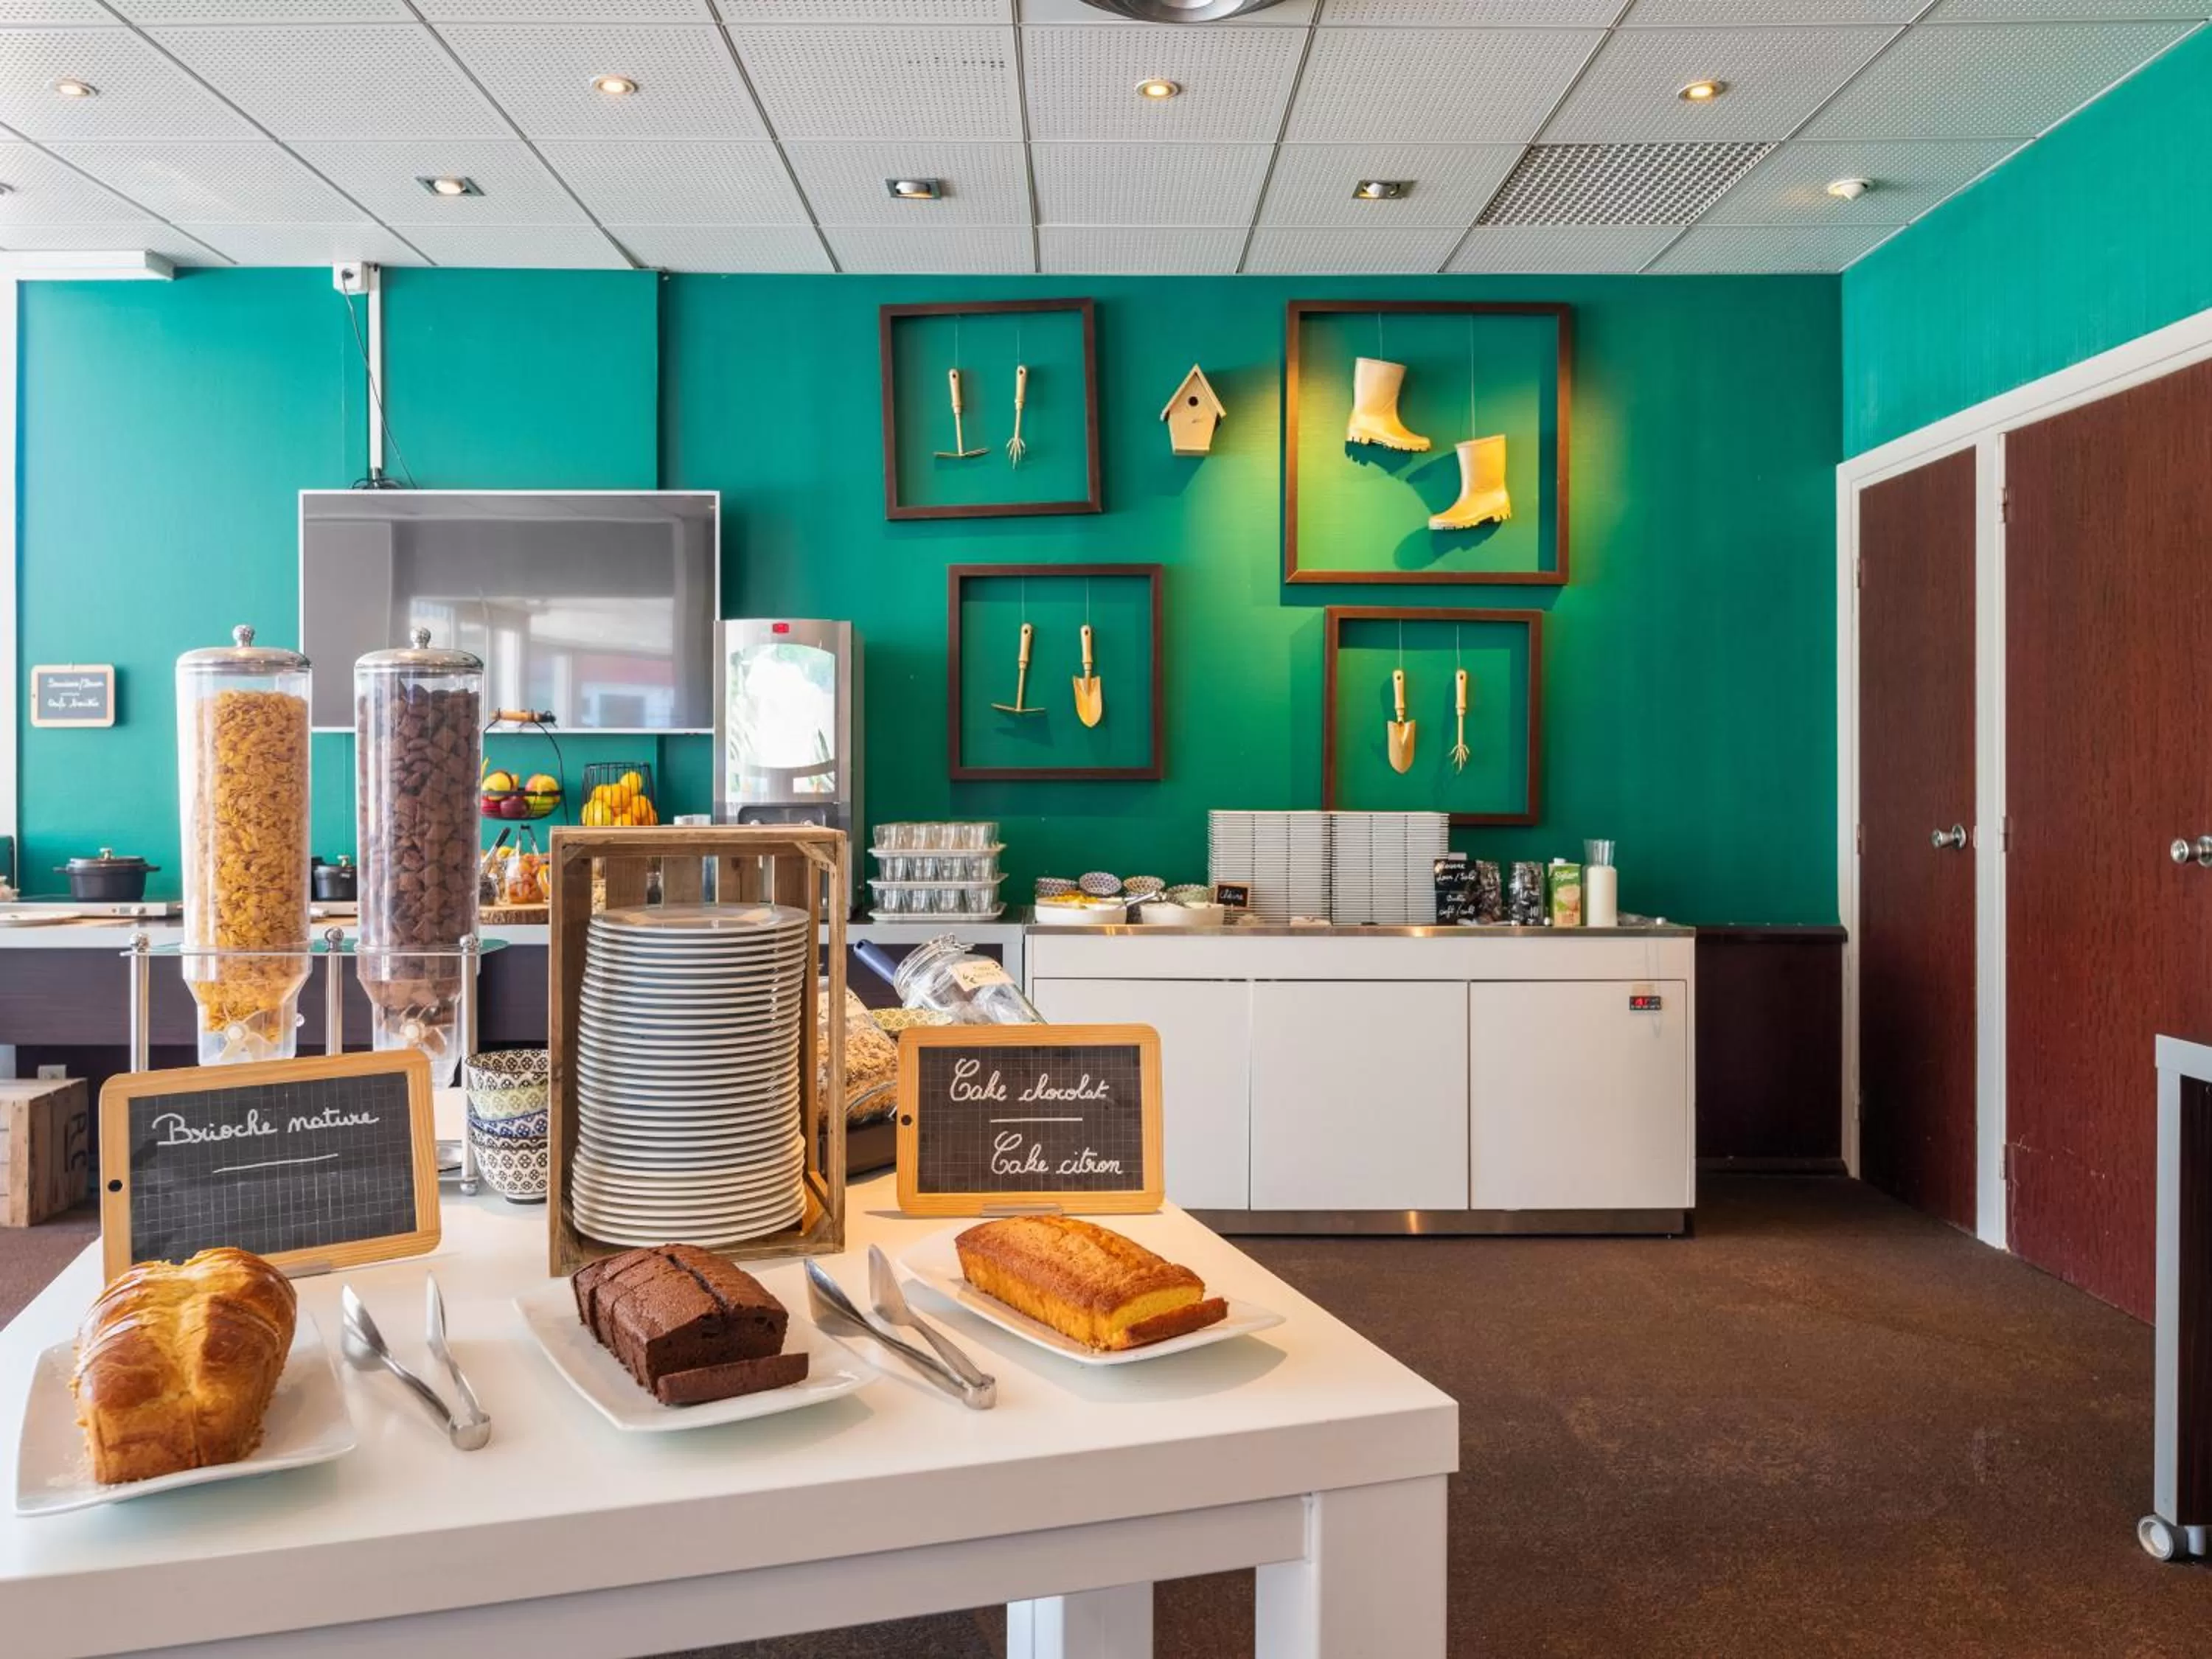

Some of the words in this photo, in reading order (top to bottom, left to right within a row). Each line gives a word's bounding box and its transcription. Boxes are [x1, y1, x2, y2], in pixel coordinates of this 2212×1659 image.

[949, 1058, 1008, 1102] Cake
[1018, 1073, 1110, 1102] chocolat
[151, 1108, 278, 1146] Brioche
[287, 1106, 380, 1134] nature
[990, 1130, 1050, 1175] Cake
[1055, 1147, 1123, 1175] citron
